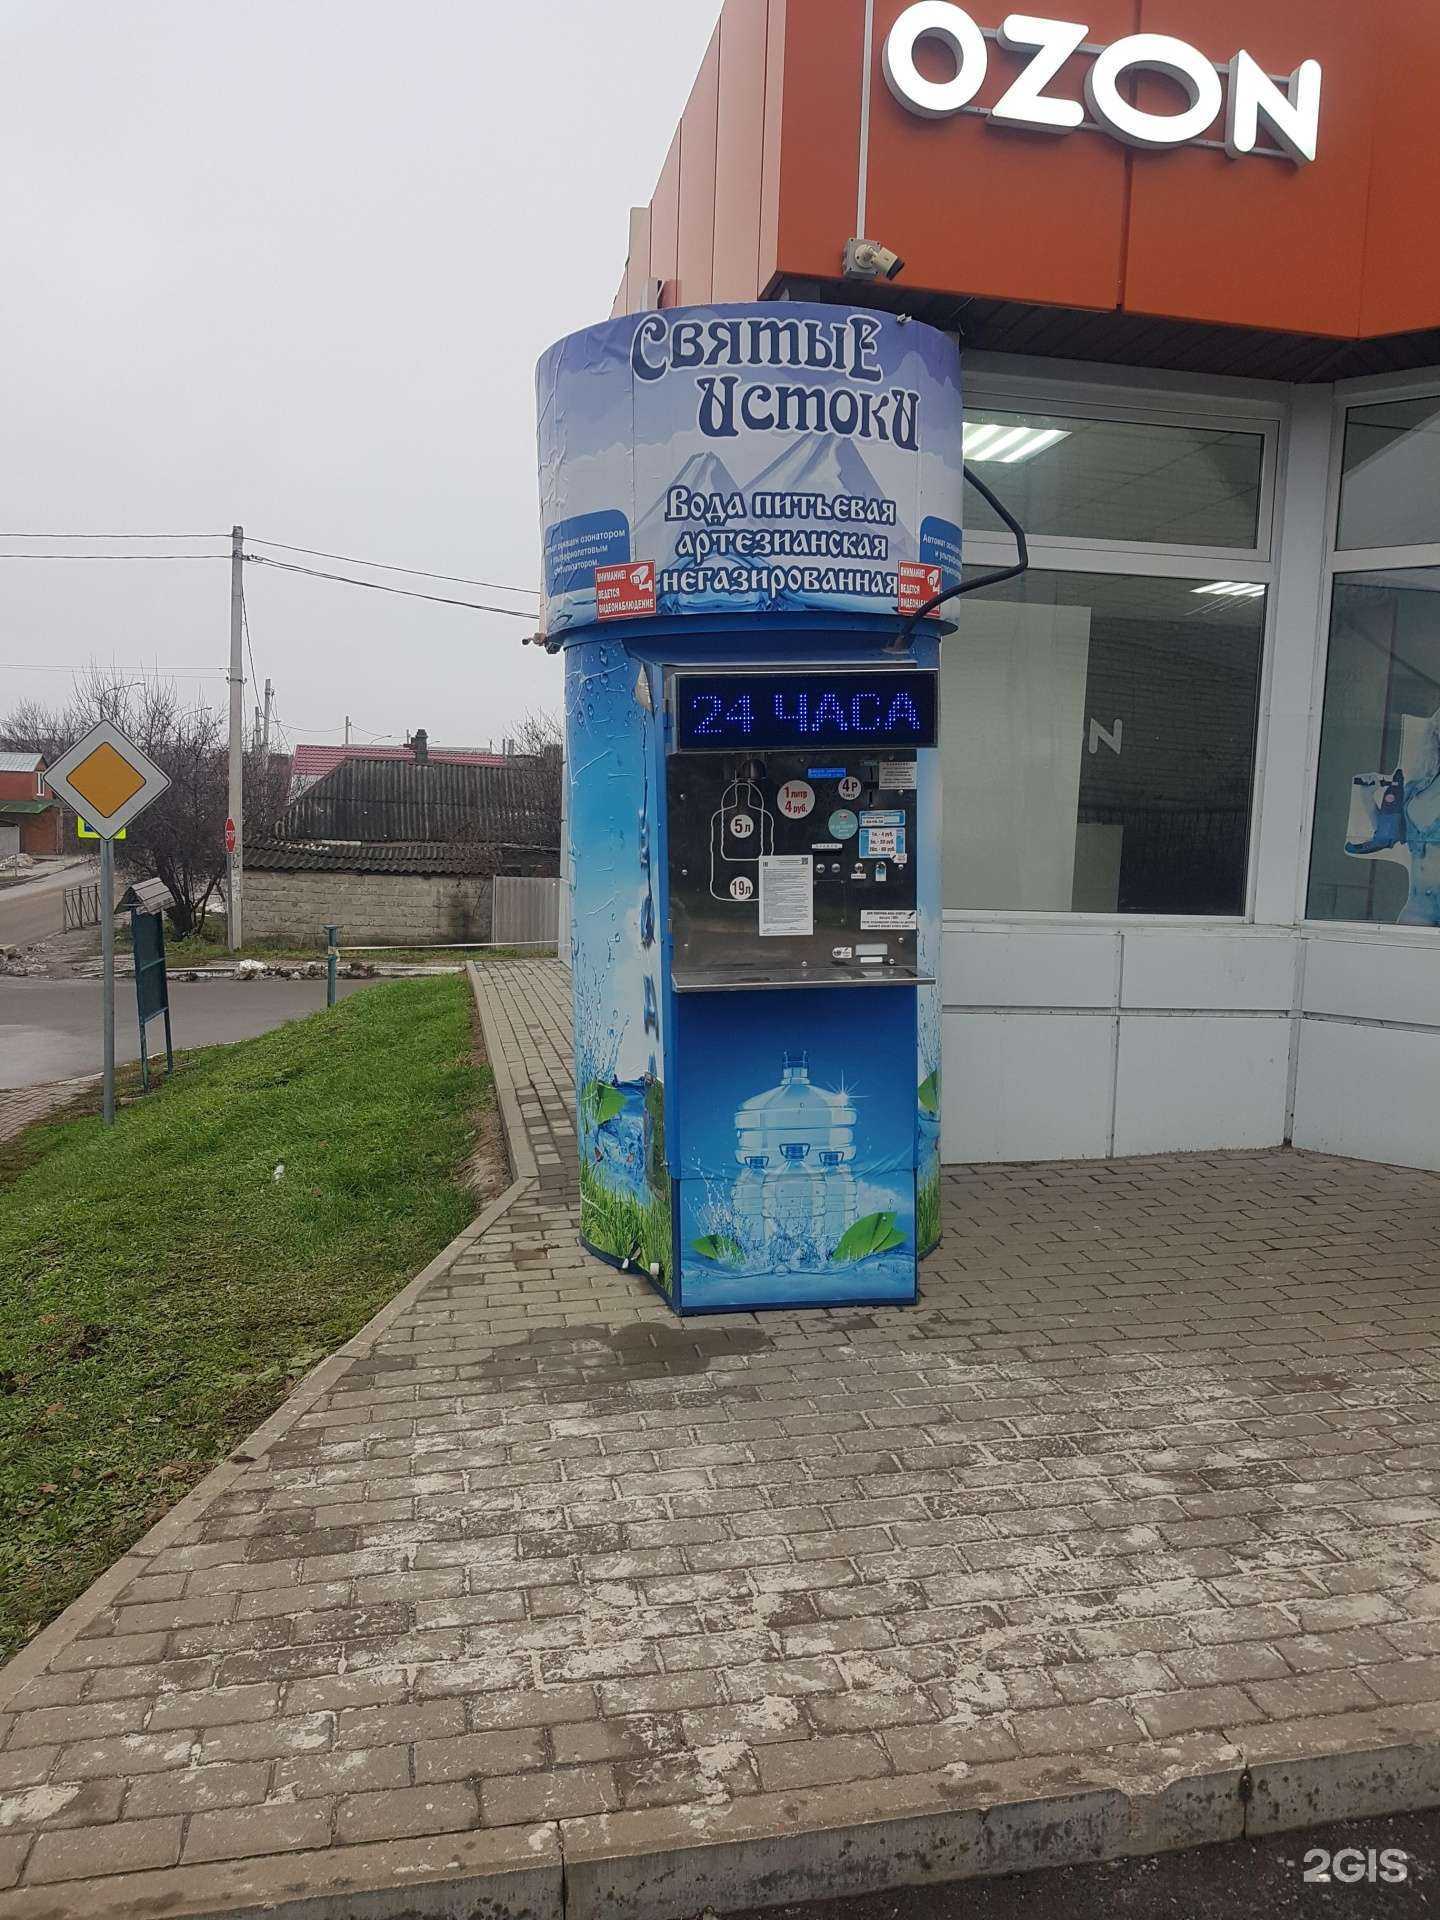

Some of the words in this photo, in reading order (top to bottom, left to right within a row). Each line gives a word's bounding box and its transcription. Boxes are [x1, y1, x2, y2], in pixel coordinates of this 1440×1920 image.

[882, 0, 1322, 163] OZON
[666, 486, 746, 526] Вода
[753, 492, 896, 525] питьевая
[676, 530, 888, 564] артезианская
[661, 567, 898, 599] негазированная
[694, 695, 755, 733] 24
[775, 693, 920, 732] ЧАСА
[784, 786, 790, 798] 1
[791, 791, 808, 799] литр
[842, 779, 850, 791] 4
[785, 800, 792, 812] 4
[793, 803, 808, 814] руб.
